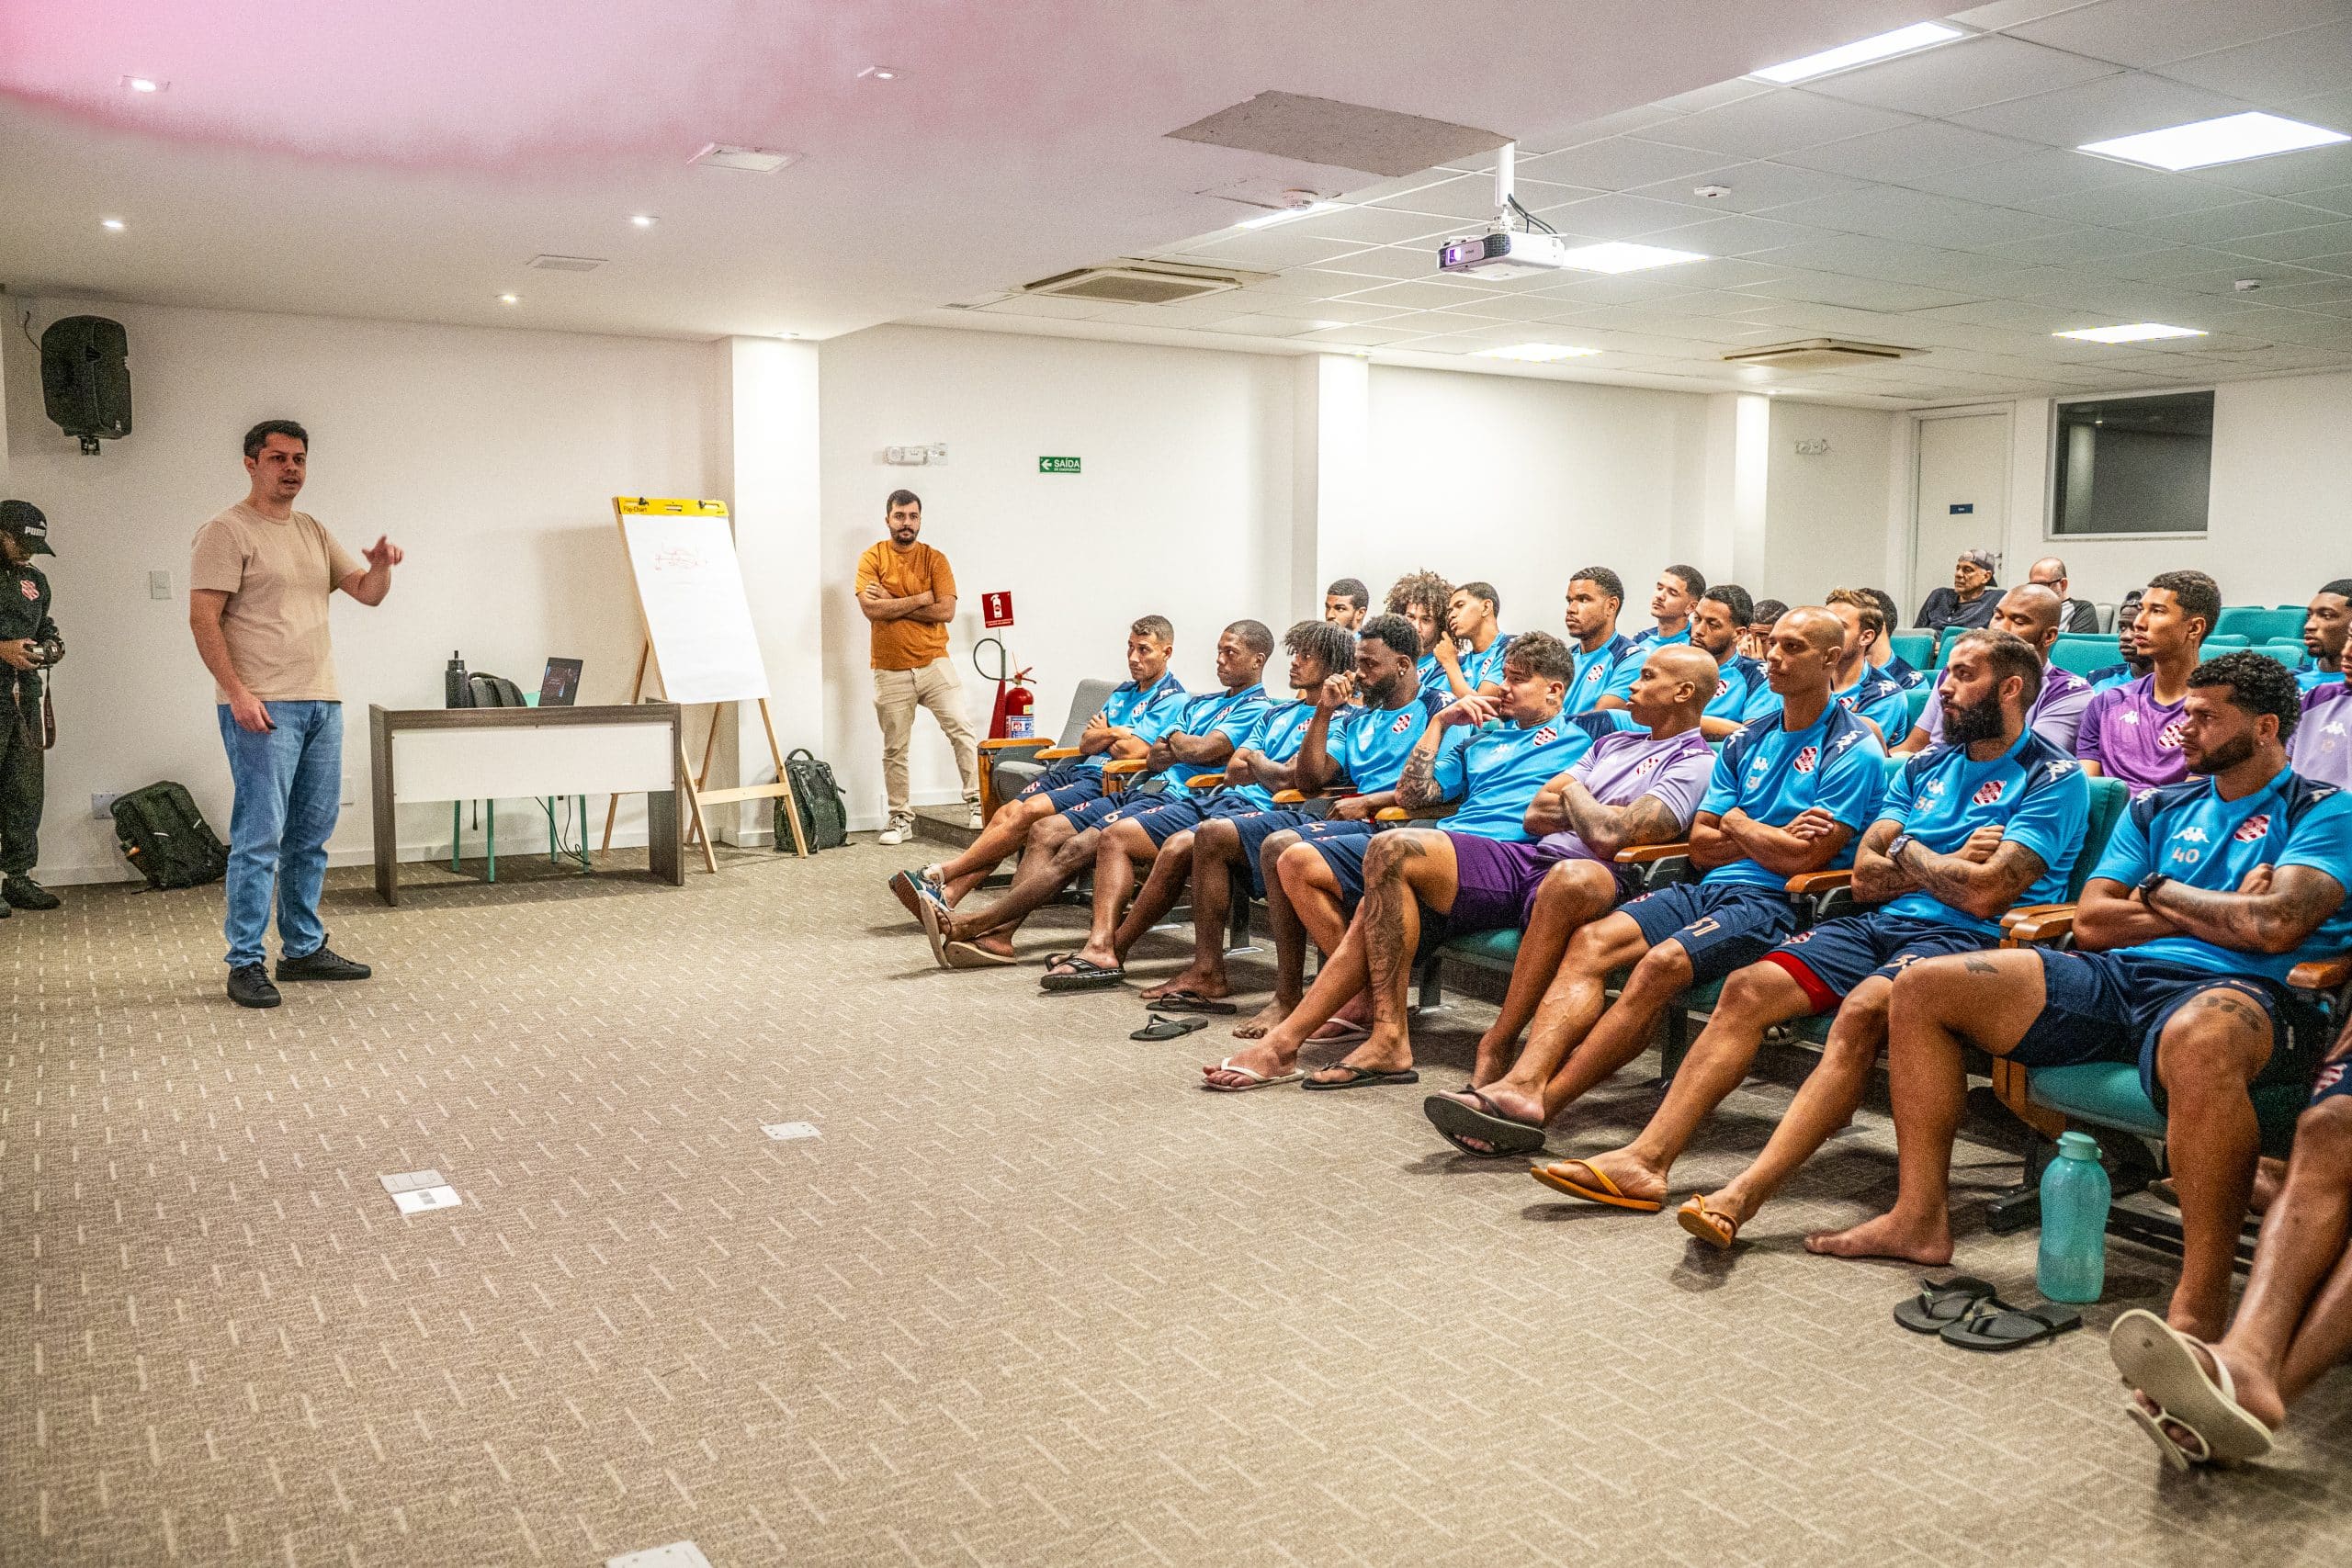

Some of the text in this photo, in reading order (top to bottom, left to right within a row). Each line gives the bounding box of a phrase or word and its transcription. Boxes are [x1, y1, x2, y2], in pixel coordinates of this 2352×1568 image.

[1054, 457, 1080, 468] SAÍDA
[1102, 810, 1124, 823] 6
[2172, 846, 2200, 863] 40
